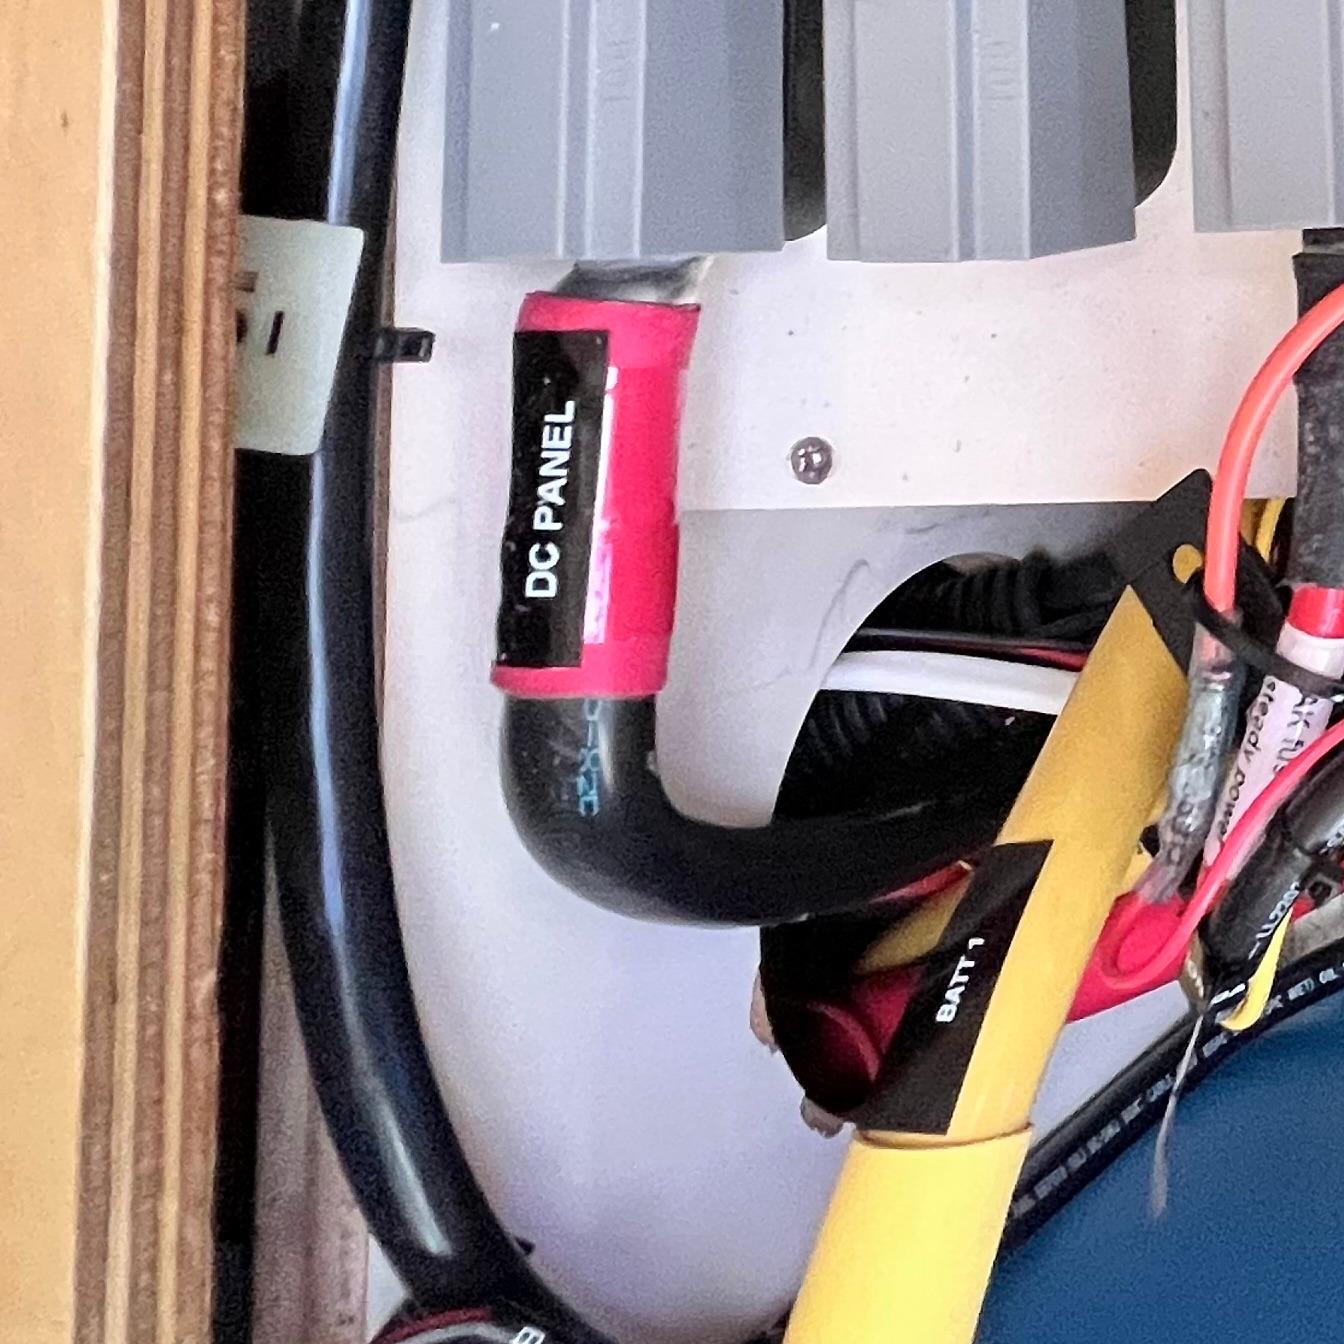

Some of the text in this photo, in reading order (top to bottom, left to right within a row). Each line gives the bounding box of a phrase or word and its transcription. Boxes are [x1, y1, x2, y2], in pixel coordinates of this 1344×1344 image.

[525, 400, 578, 600] DC PANEL
[935, 936, 986, 1025] BATT 1
